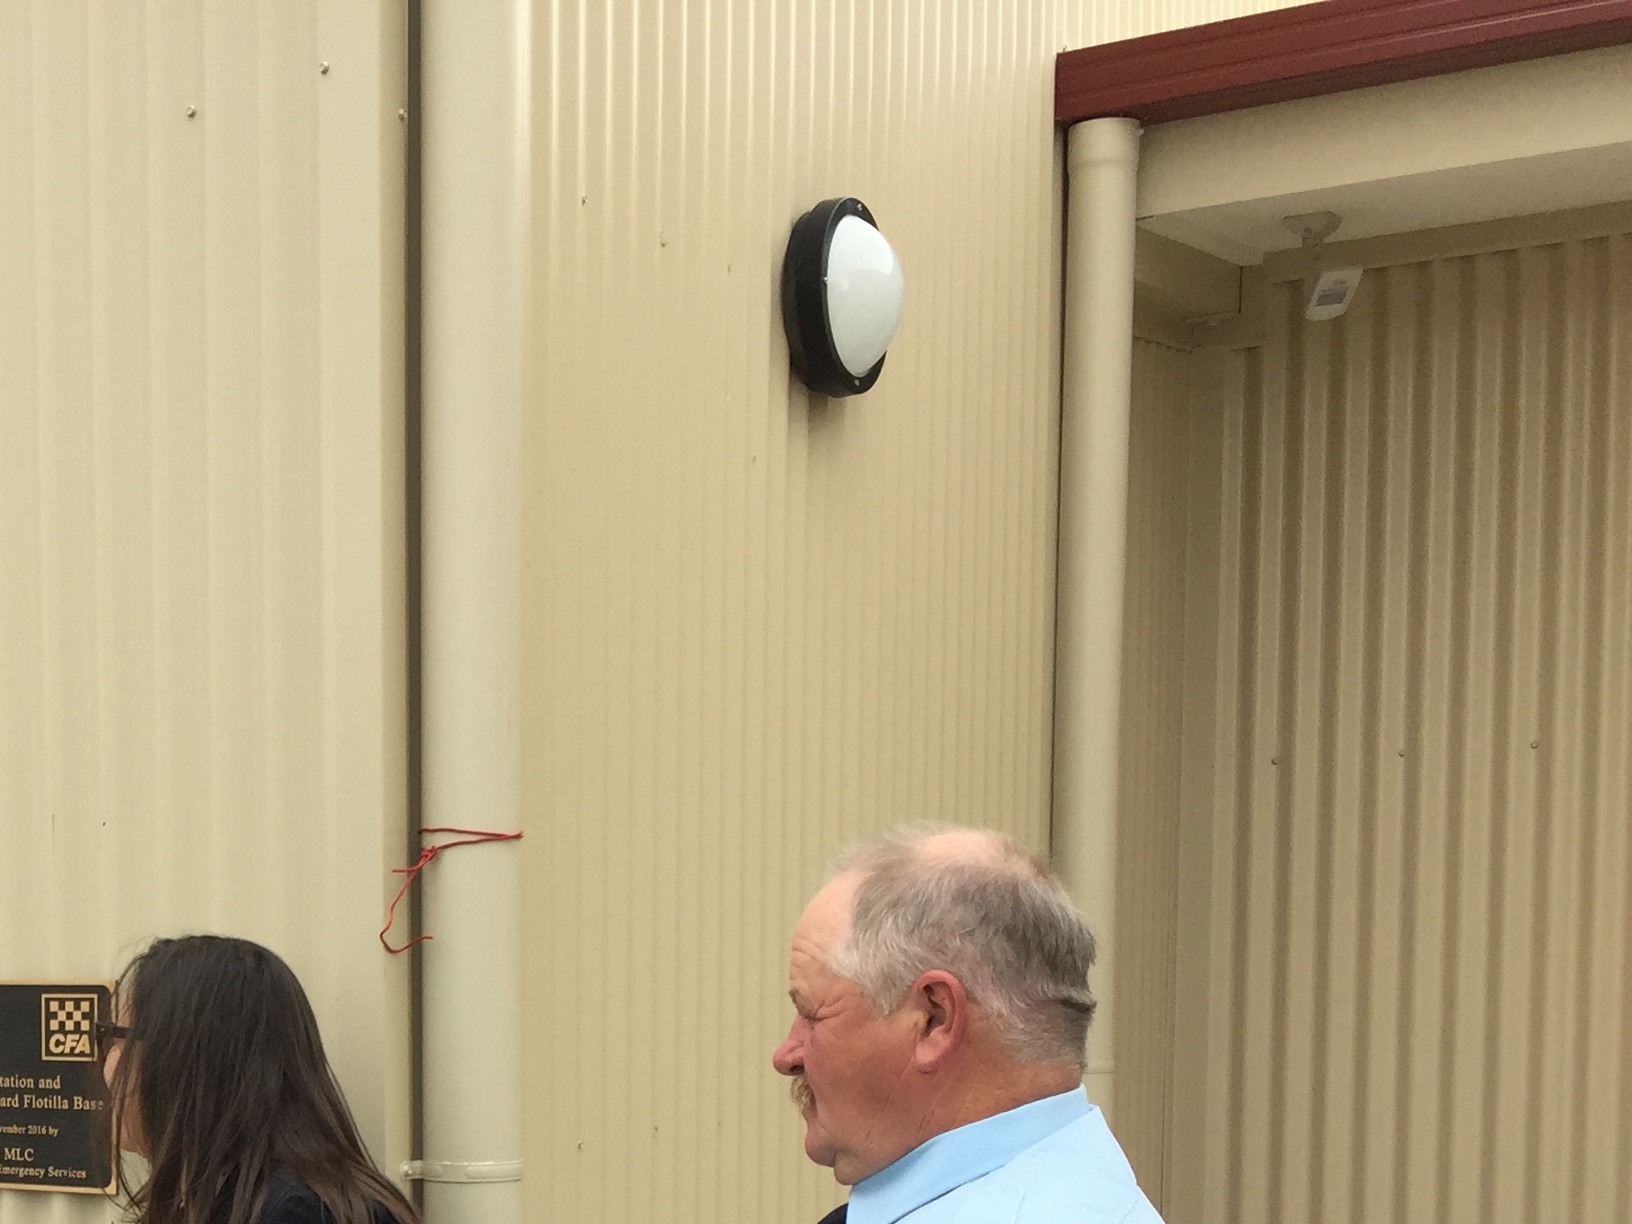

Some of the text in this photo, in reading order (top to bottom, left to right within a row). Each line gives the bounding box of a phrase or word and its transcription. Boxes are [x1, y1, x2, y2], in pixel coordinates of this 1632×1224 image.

[49, 1033, 91, 1054] CFA
[38, 1075, 61, 1089] and
[23, 1094, 69, 1109] Flotilla
[73, 1096, 104, 1110] Base
[28, 1125, 47, 1134] 2016
[49, 1126, 59, 1137] by
[4, 1147, 35, 1161] MLC
[48, 1166, 87, 1178] Services
